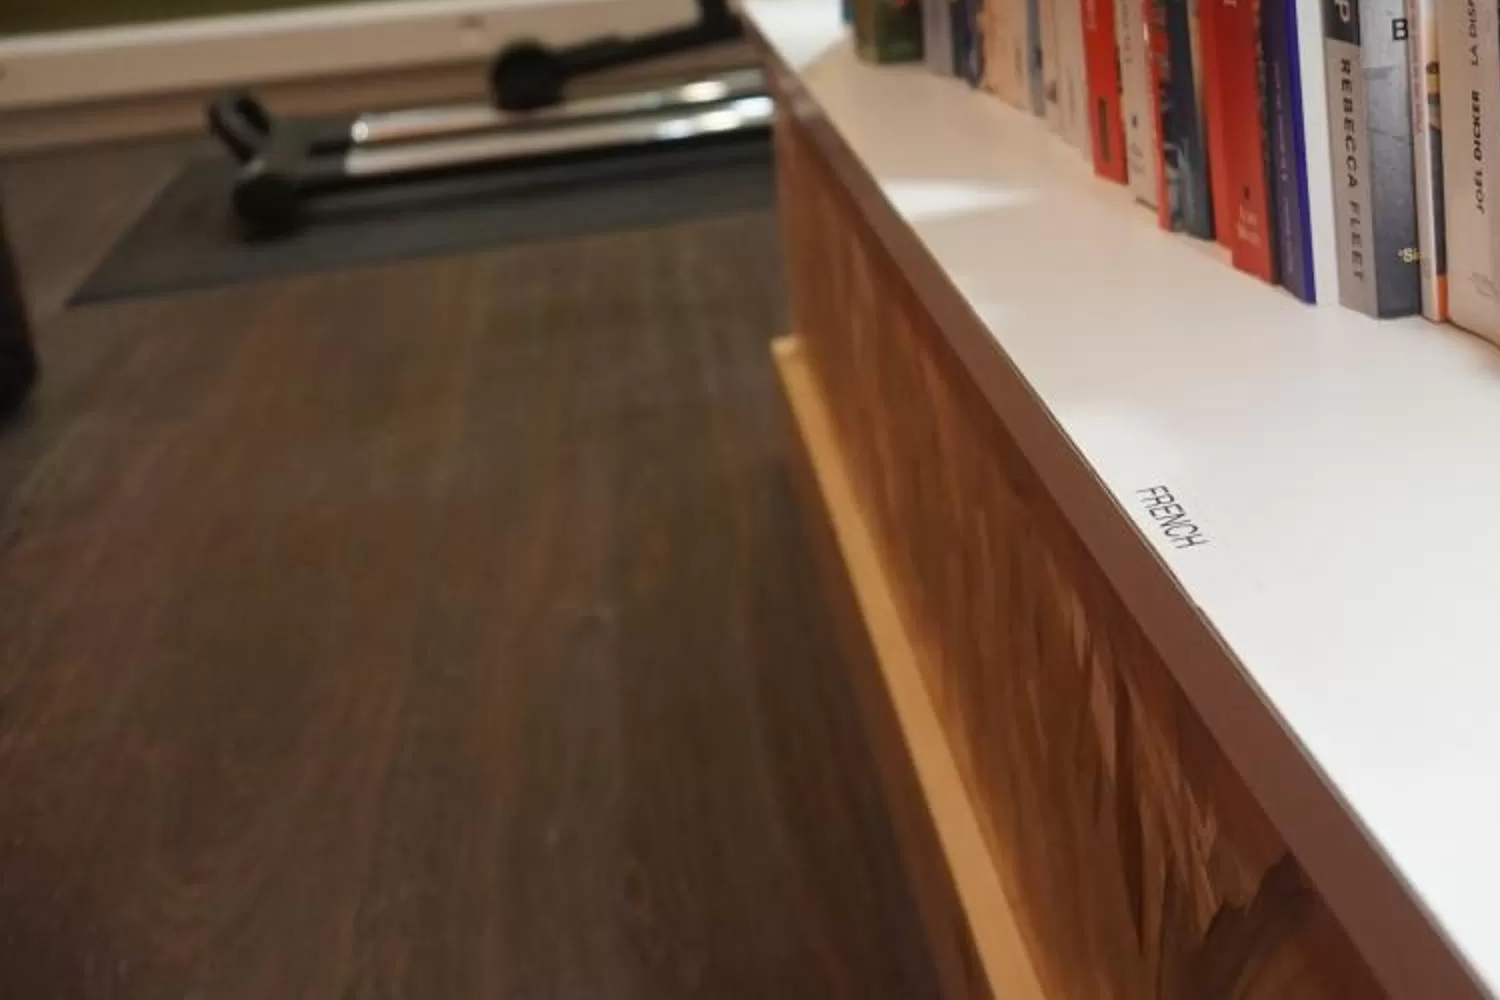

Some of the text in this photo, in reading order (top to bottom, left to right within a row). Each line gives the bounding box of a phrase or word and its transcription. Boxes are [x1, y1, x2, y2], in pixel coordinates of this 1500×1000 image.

[1471, 44, 1478, 66] LA
[1472, 90, 1482, 161] DICKER
[1341, 58, 1363, 282] REBECCA FLEET
[1135, 485, 1210, 549] FRENCH
